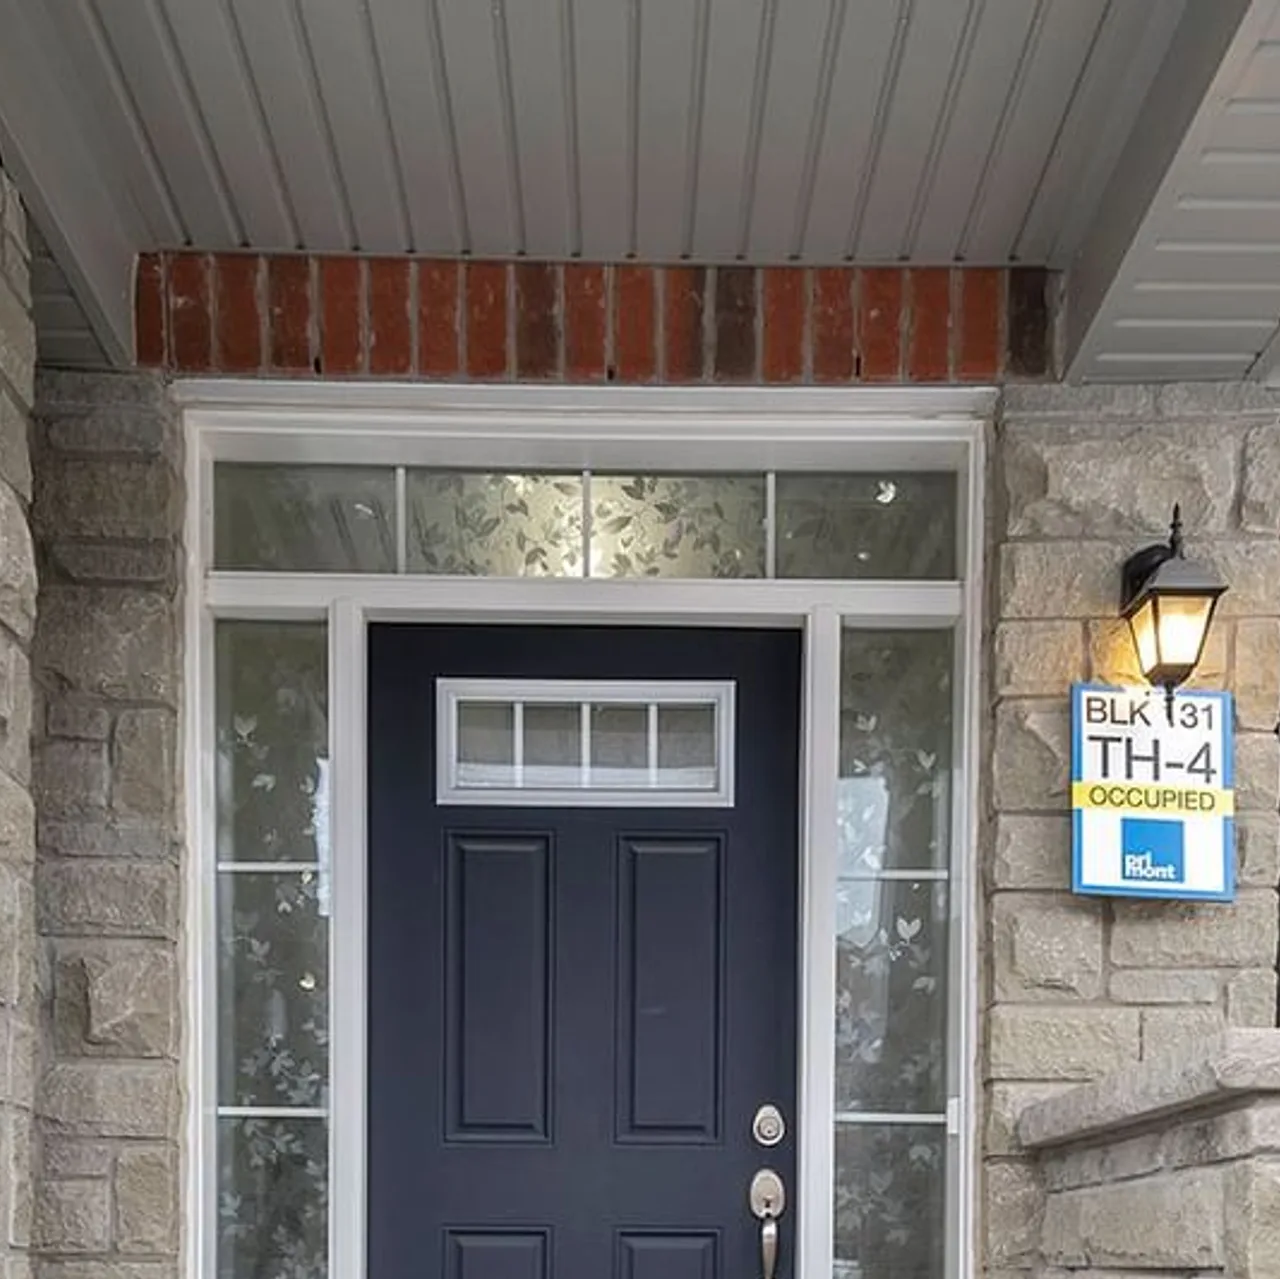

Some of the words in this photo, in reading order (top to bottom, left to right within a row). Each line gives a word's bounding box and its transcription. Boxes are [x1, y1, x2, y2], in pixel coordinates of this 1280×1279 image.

[1085, 696, 1152, 728] BLK
[1087, 734, 1218, 785] TH-4
[1088, 784, 1216, 812] OCCUPIED
